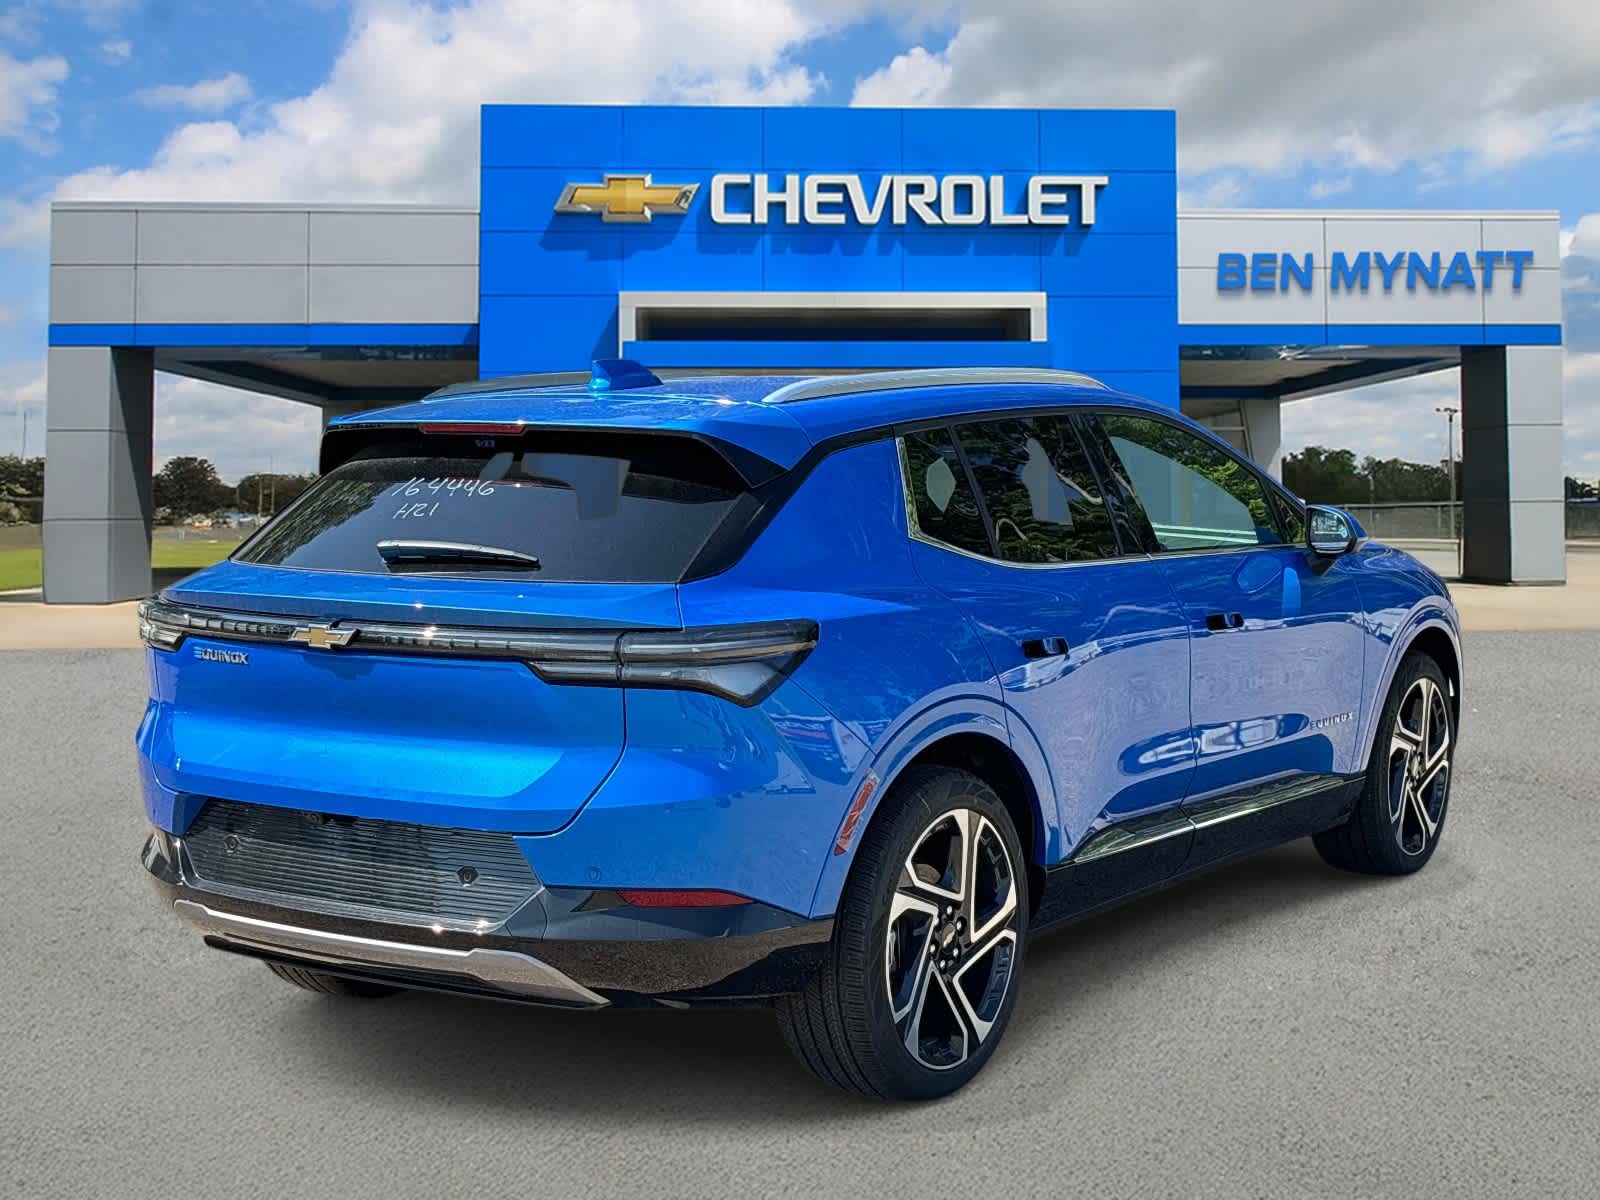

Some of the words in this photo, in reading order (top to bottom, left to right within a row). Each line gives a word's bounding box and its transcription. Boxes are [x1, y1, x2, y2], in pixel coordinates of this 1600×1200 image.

[710, 173, 1109, 225] CHEVROLET
[1217, 252, 1313, 290] BEN
[1330, 250, 1534, 290] MYNATT
[391, 476, 496, 497] 164446
[193, 646, 248, 664] EQUINOX
